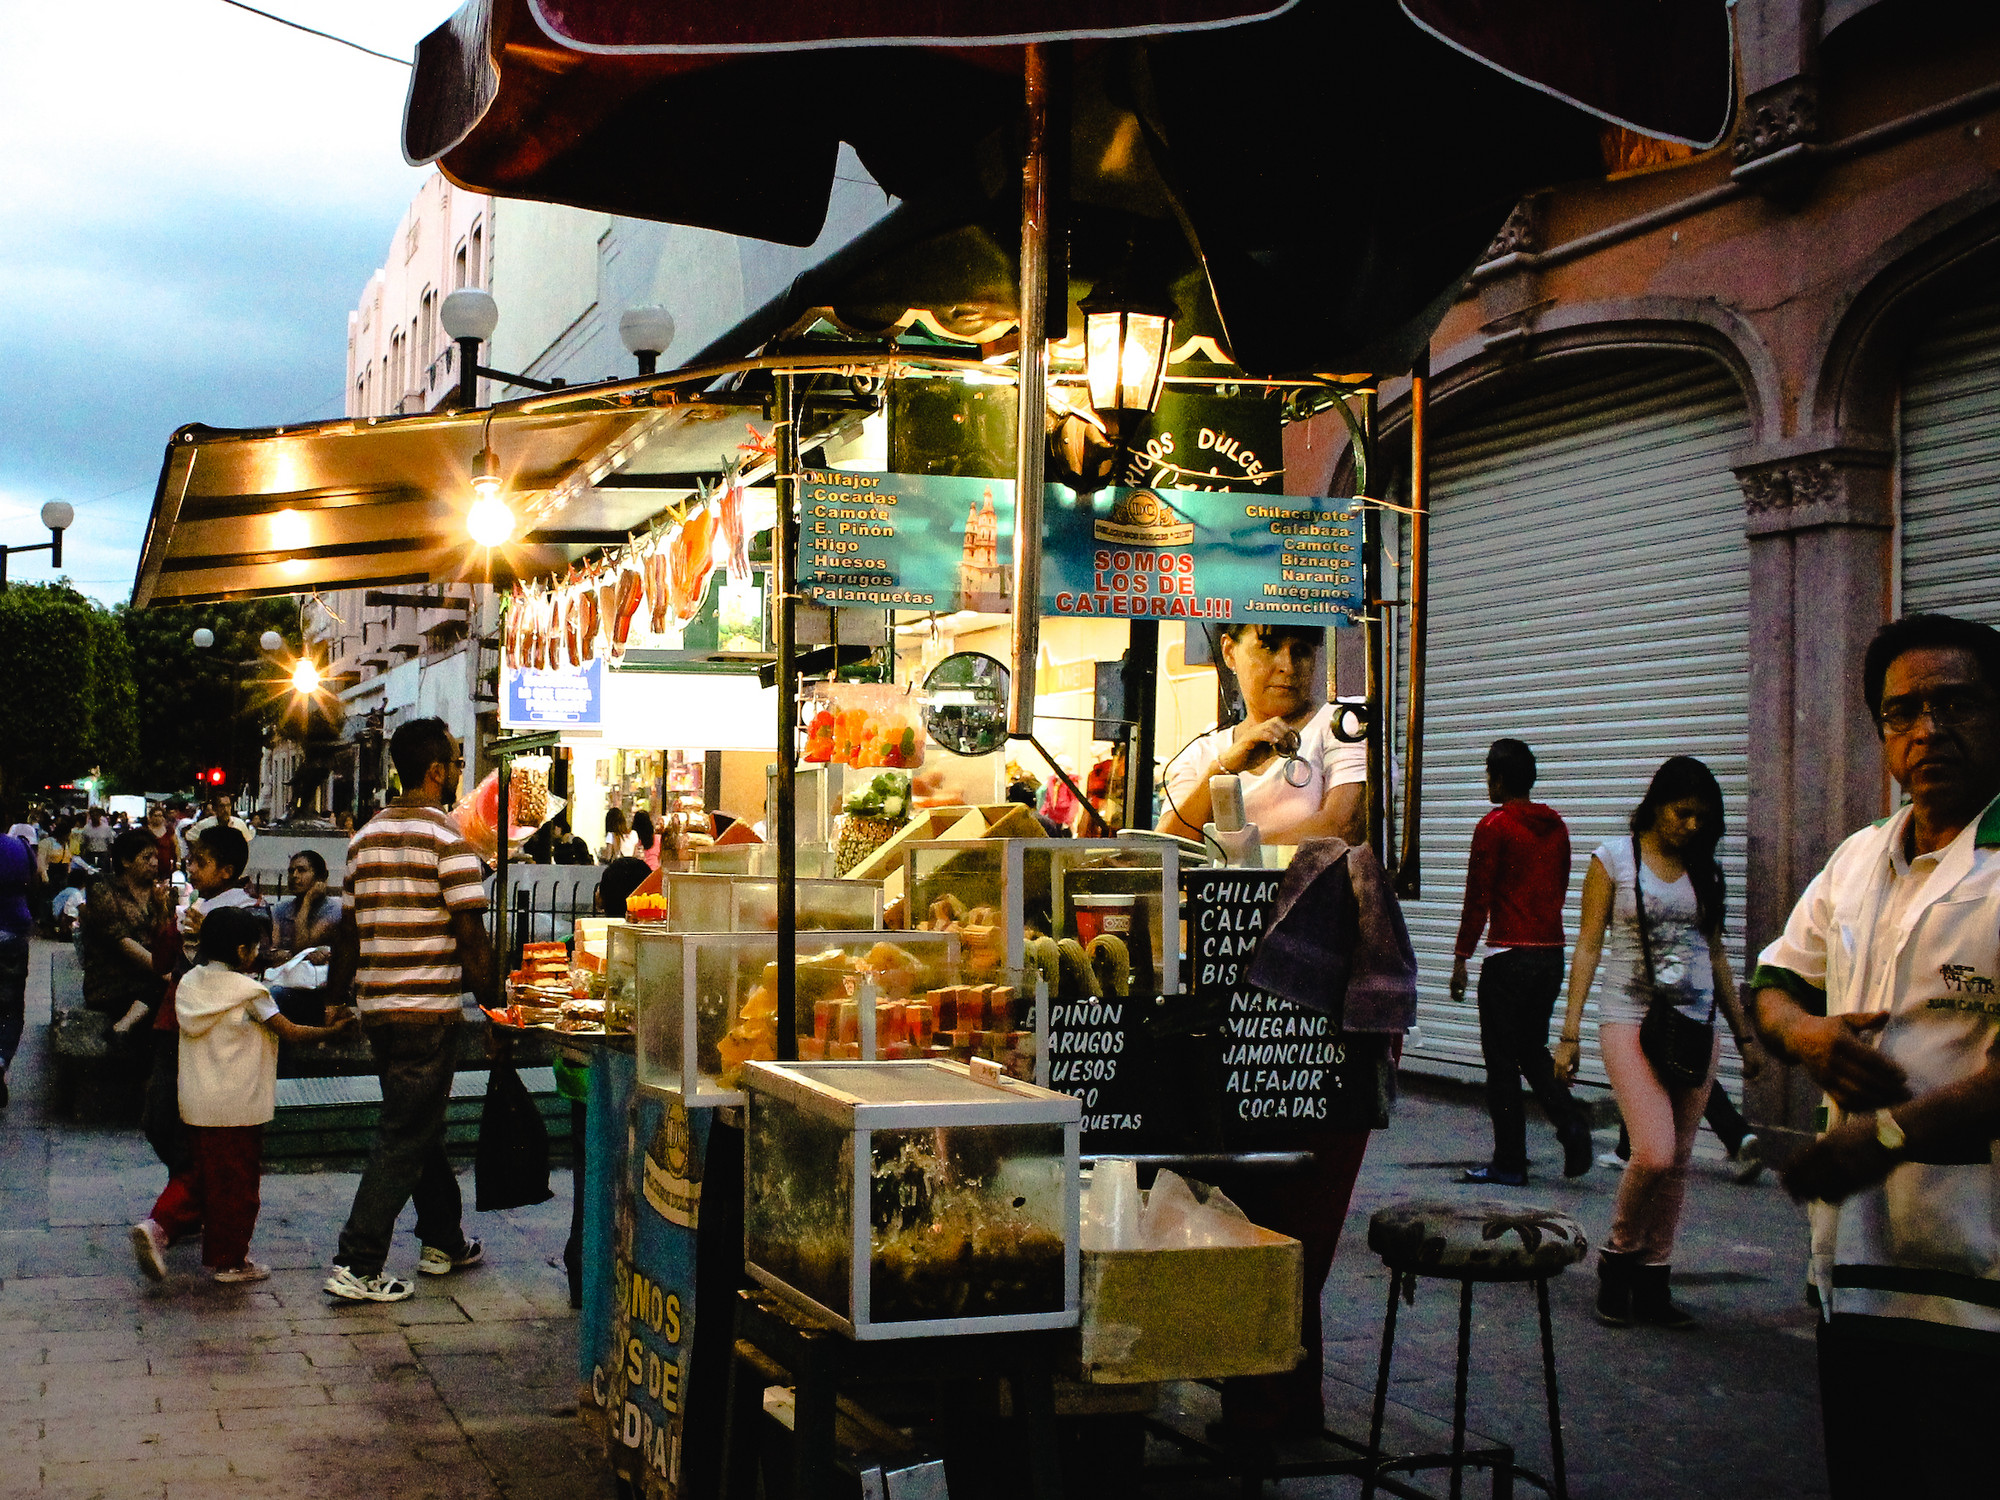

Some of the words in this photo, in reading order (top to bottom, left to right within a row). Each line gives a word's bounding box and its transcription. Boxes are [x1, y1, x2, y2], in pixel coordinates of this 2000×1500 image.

[839, 522, 895, 537] Piñón
[1094, 550, 1195, 576] SOMOS
[811, 585, 935, 606] Palanquetas
[1094, 571, 1149, 595] LOS
[1157, 574, 1196, 597] DE
[1055, 591, 1233, 619] CATEDRAL!!!
[1221, 1042, 1346, 1066] JAMONCILLOS
[1049, 1059, 1117, 1082] UESOS
[1226, 1069, 1323, 1093] ALFAJOR
[1238, 1096, 1328, 1120] COCADAS
